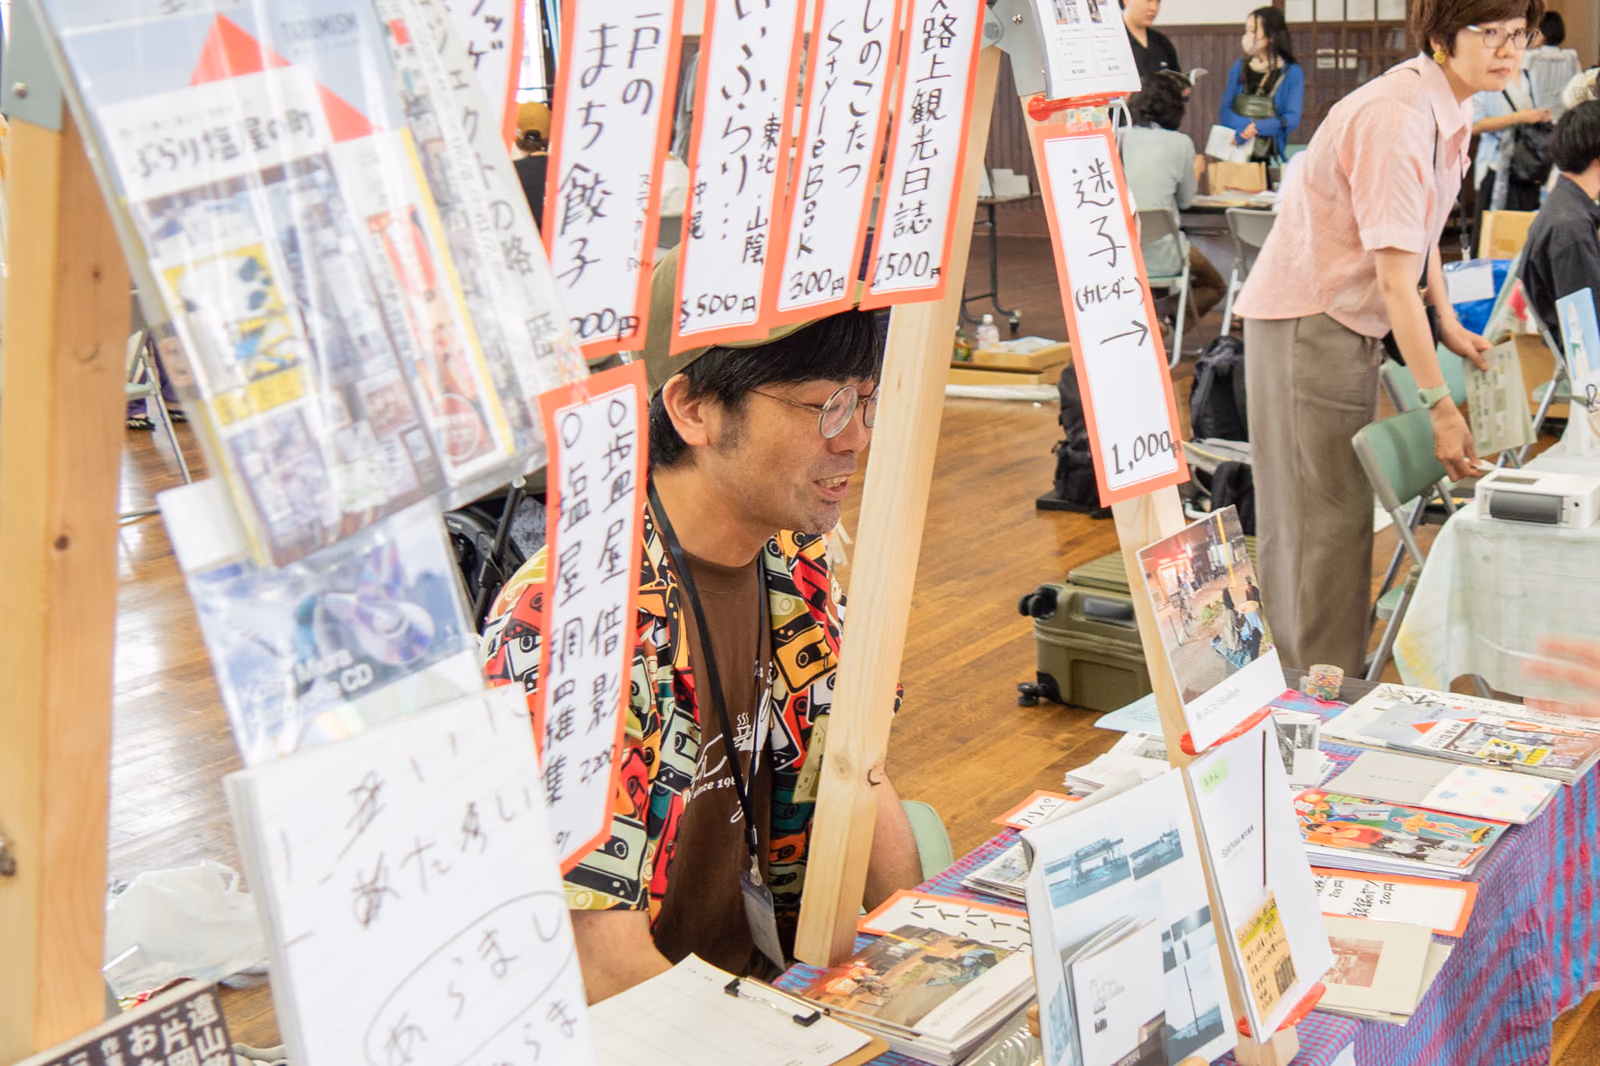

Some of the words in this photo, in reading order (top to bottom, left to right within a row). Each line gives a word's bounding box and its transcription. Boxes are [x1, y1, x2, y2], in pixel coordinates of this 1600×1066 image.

[555, 22, 620, 290] まち餃子
[1072, 157, 1127, 268] 迷子
[789, 267, 845, 301] 300円
